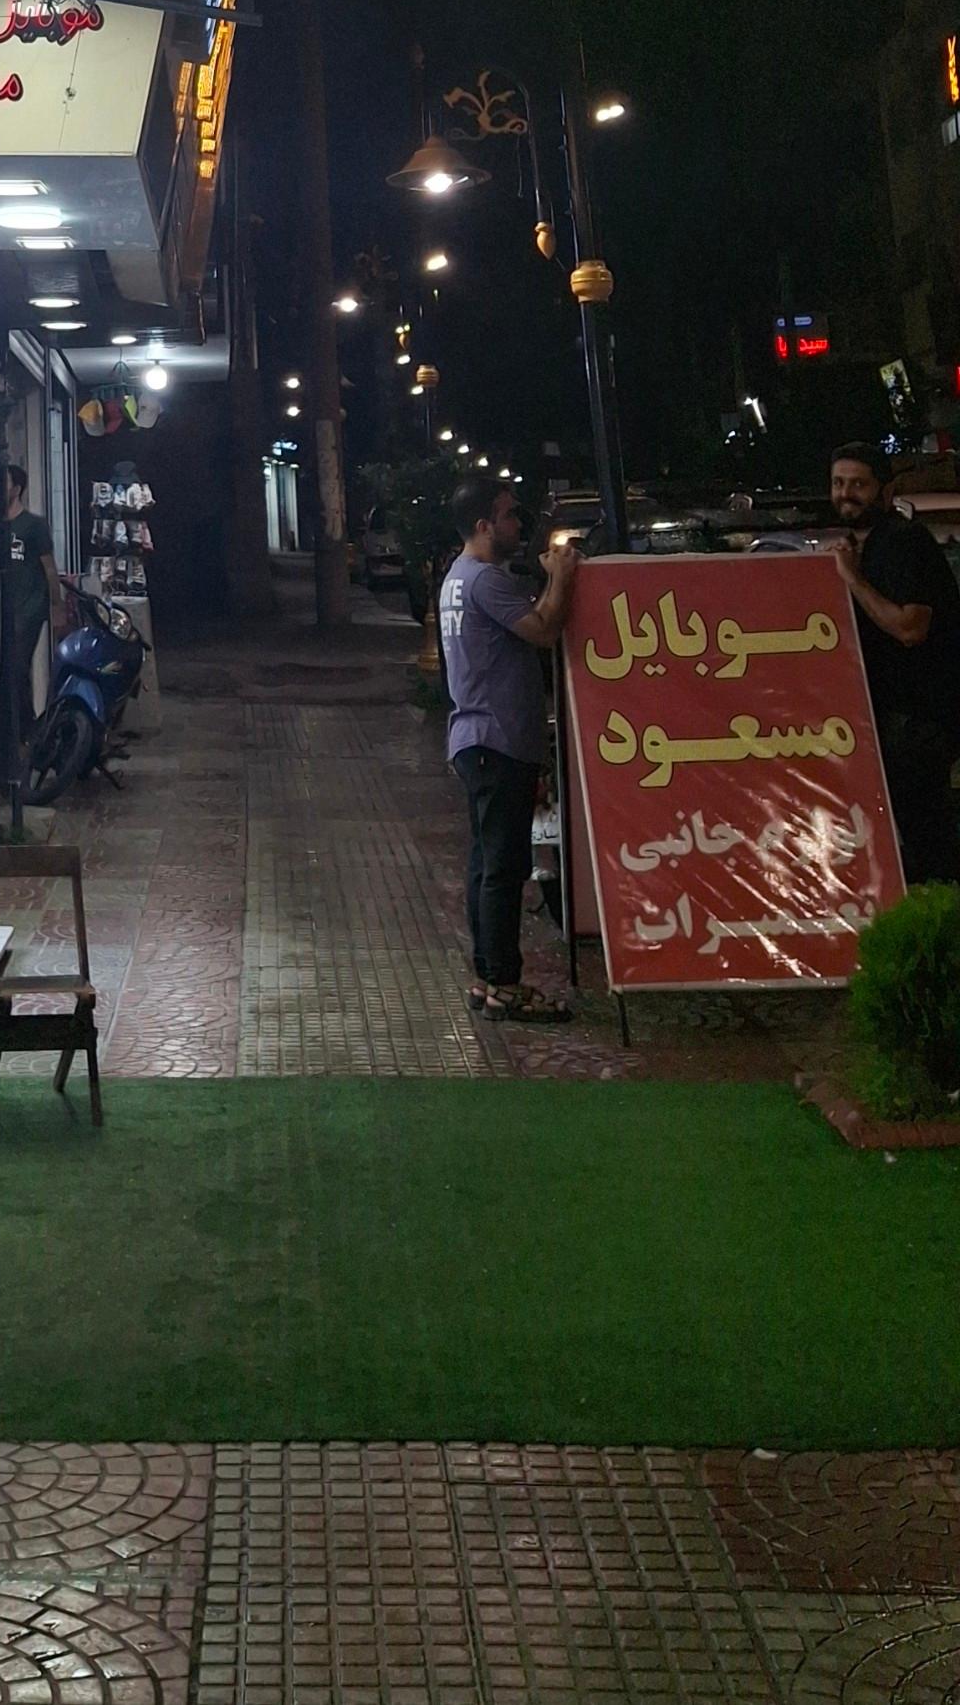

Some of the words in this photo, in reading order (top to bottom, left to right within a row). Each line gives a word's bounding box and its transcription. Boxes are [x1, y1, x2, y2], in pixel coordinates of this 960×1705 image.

[585, 589, 840, 680] موبایل
[598, 709, 857, 788] مسعود
[619, 802, 746, 872] جانبی
